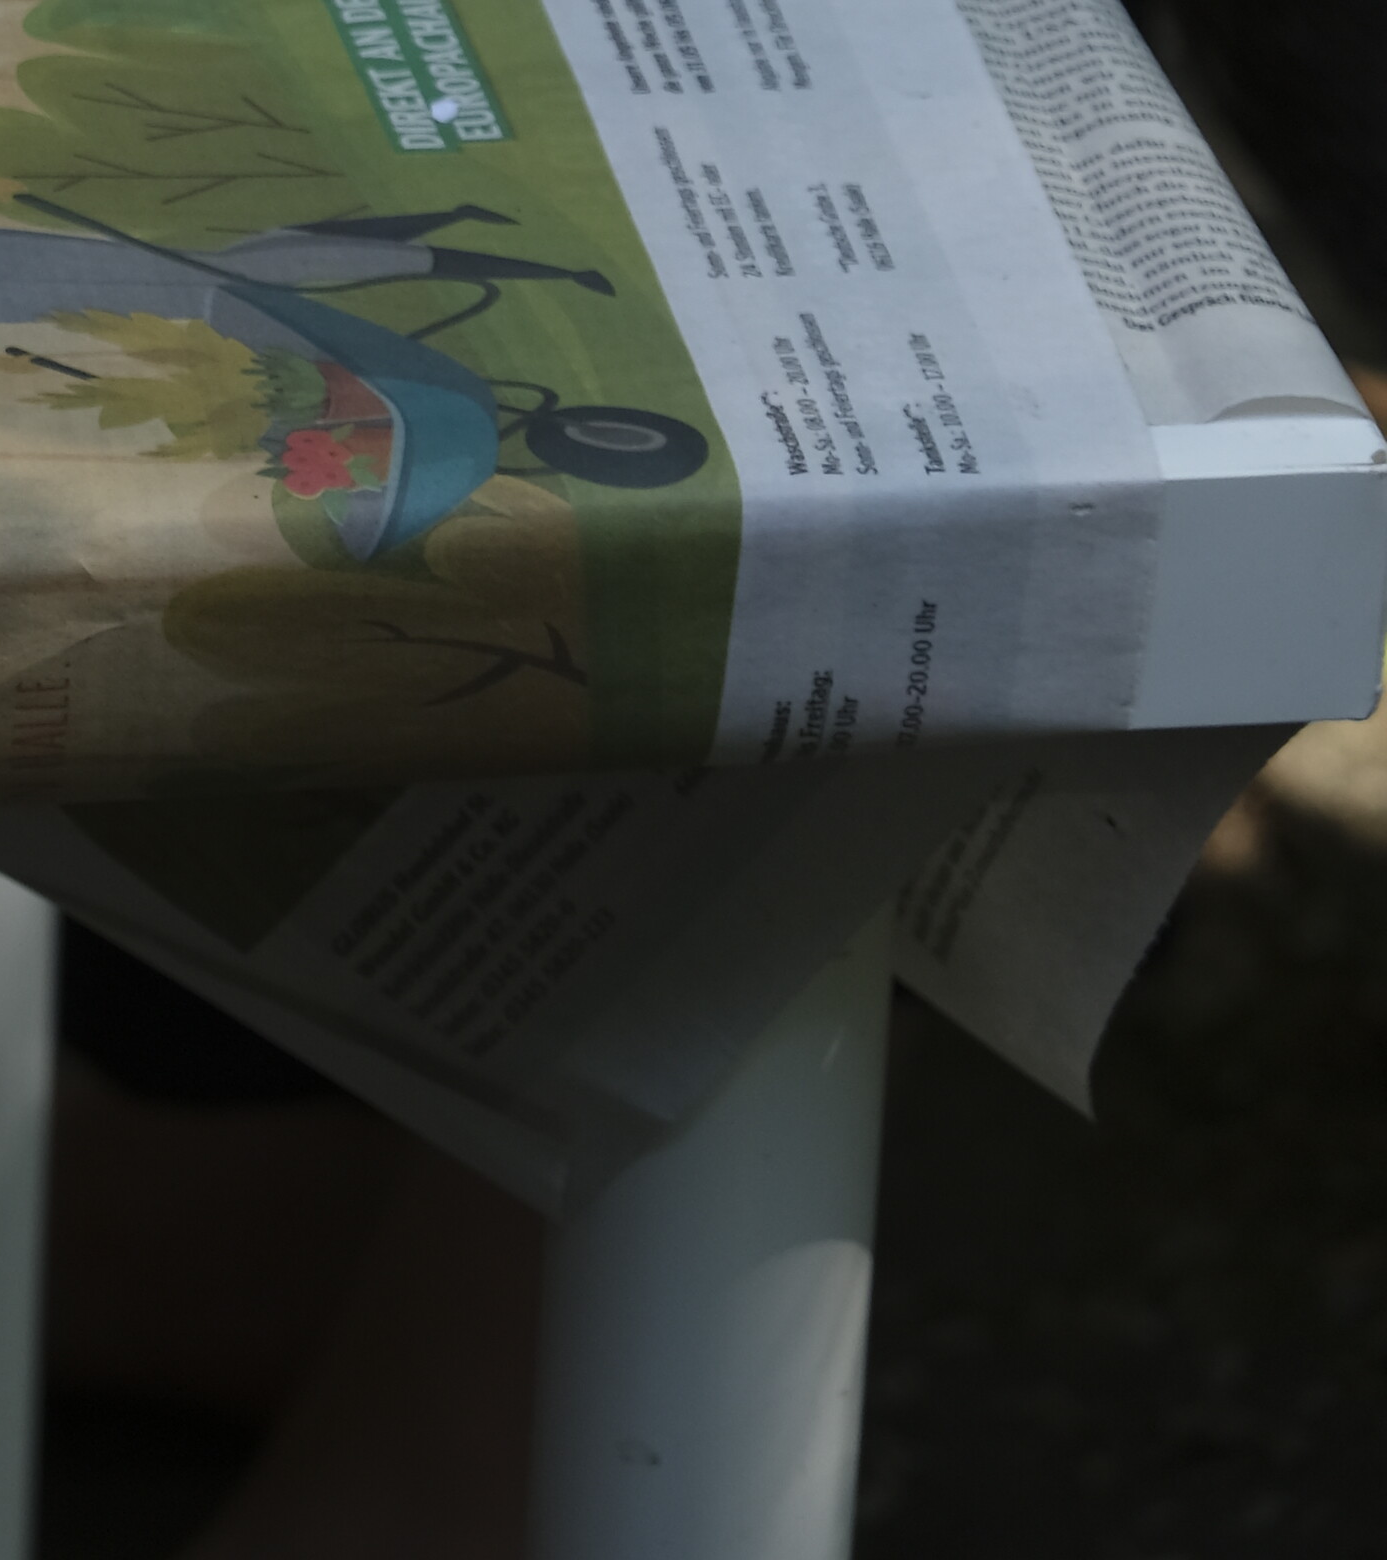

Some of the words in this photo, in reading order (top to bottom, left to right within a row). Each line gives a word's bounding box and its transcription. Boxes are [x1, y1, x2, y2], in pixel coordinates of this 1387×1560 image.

[349, 27, 405, 62] AN
[366, 67, 446, 150] DIREKT
[912, 599, 938, 634] Uhr
[798, 670, 833, 739] Freitag:
[833, 696, 859, 727] Uhr
